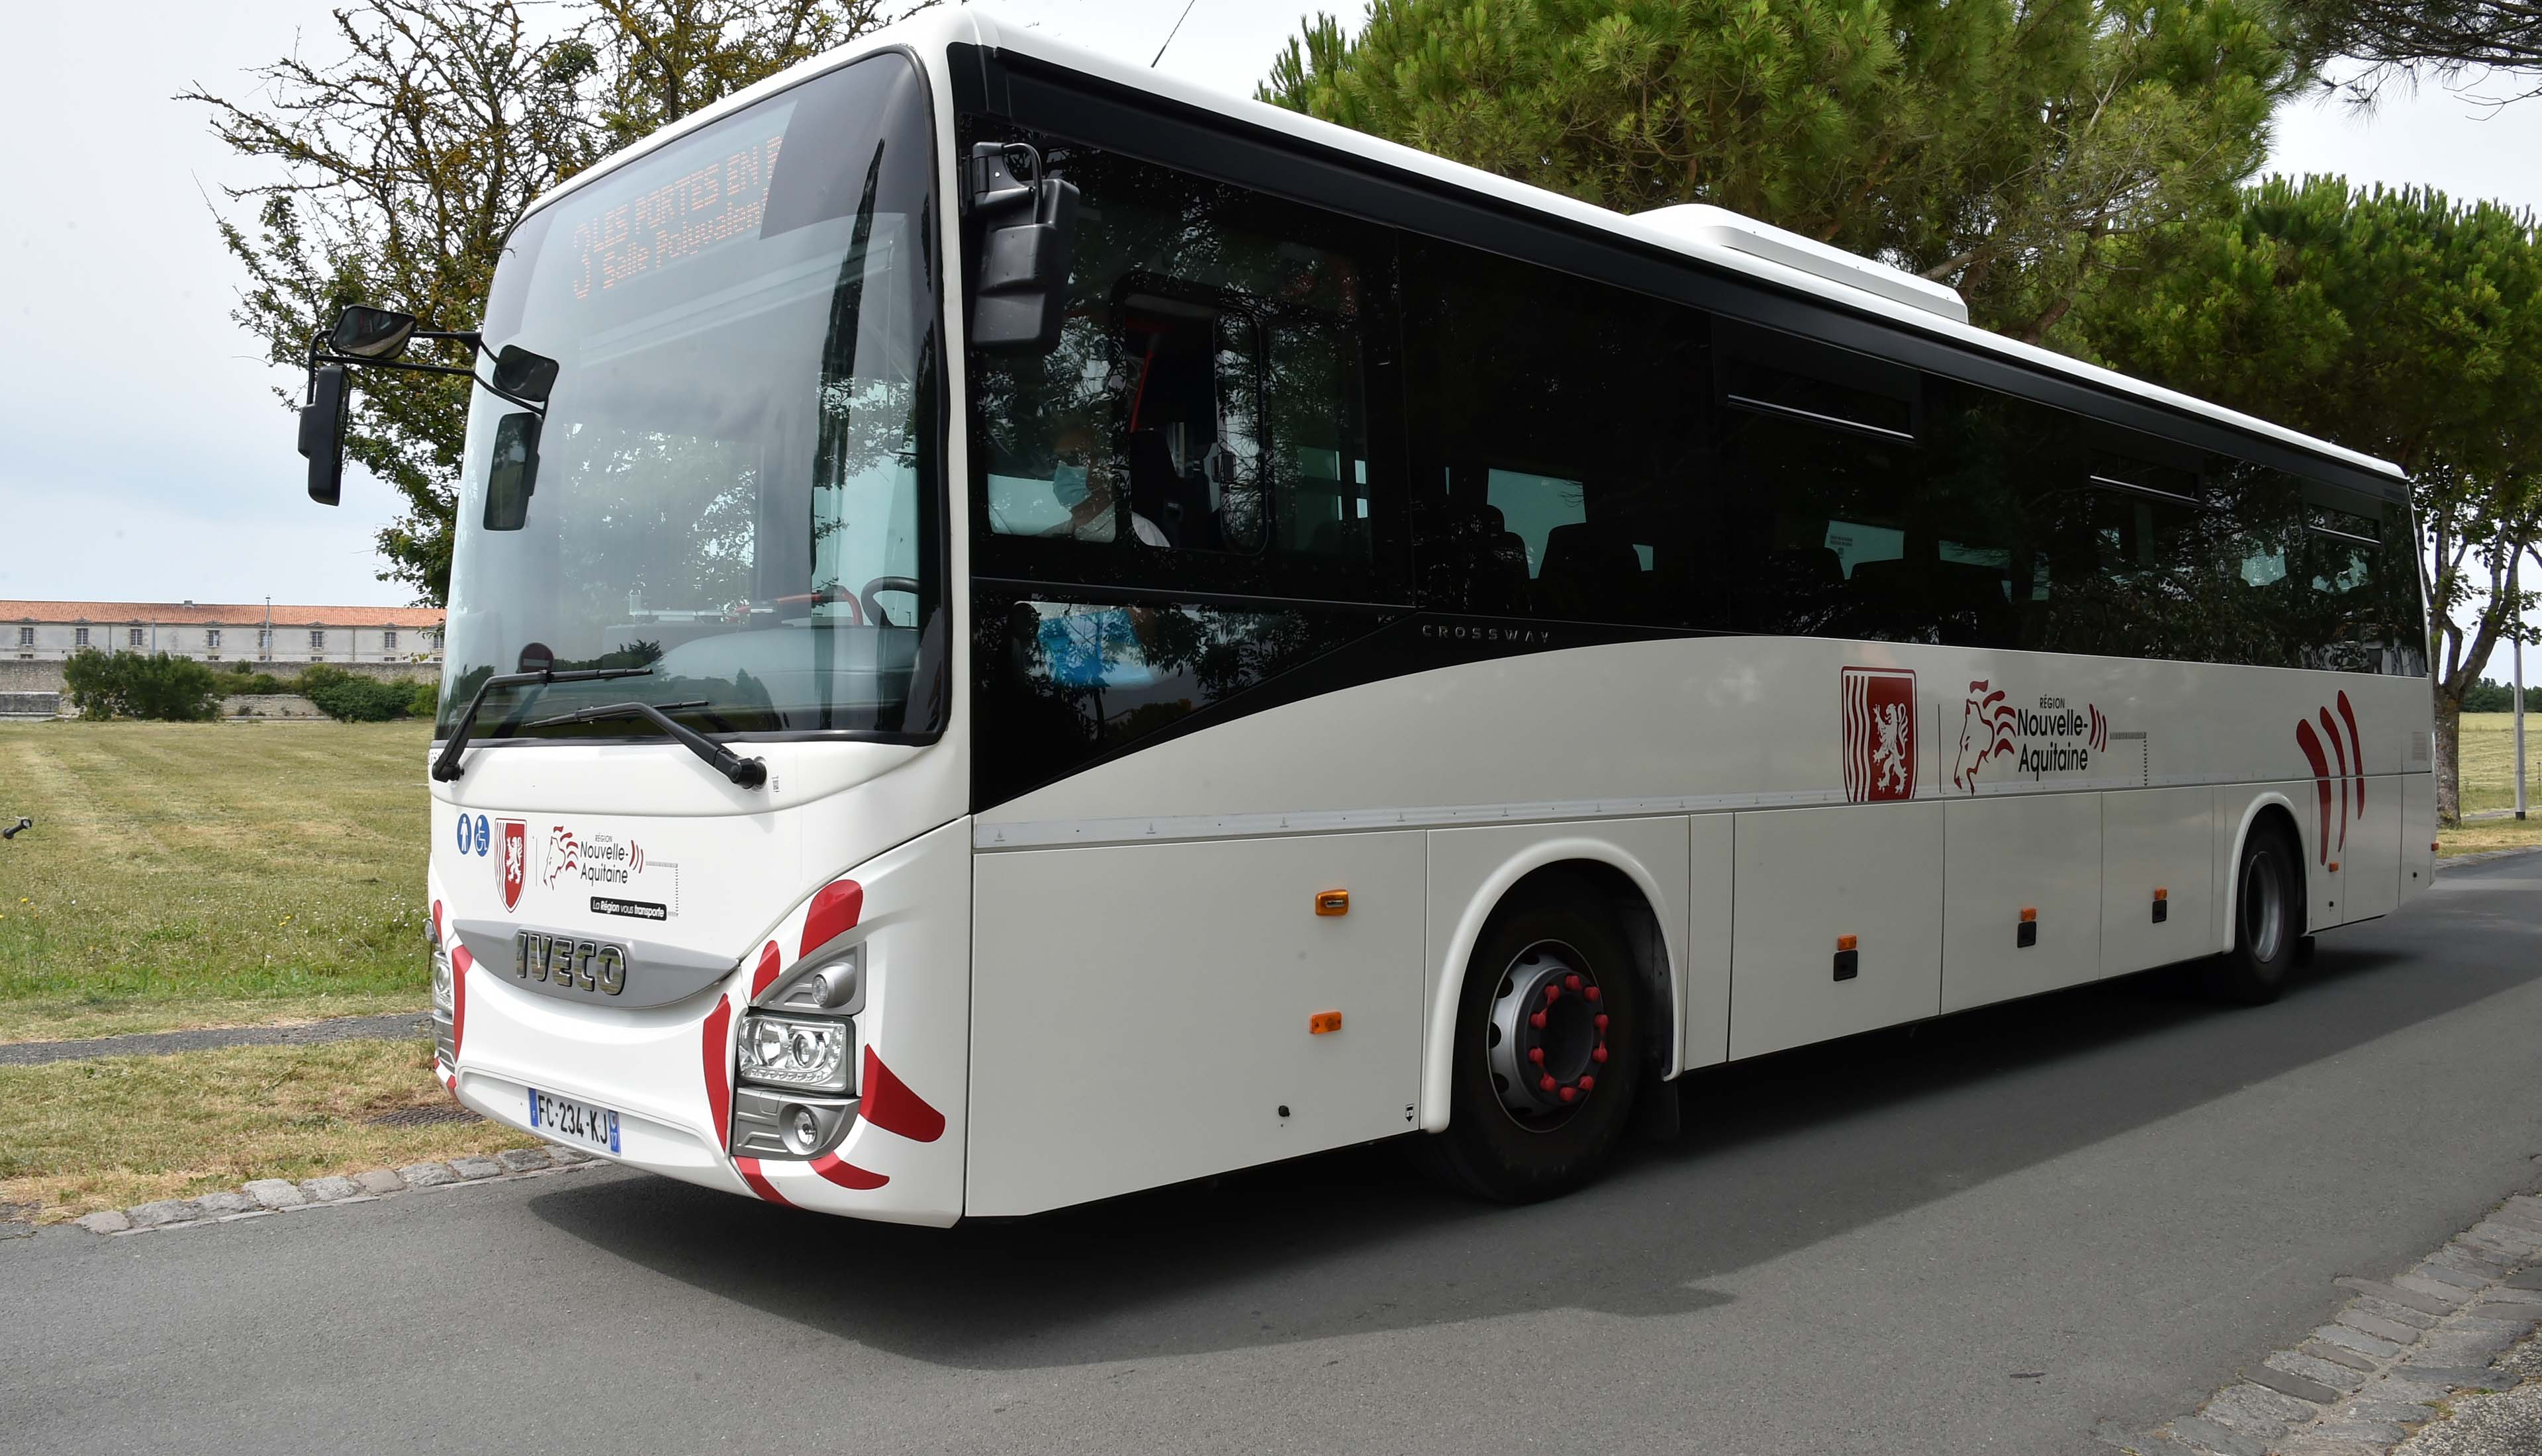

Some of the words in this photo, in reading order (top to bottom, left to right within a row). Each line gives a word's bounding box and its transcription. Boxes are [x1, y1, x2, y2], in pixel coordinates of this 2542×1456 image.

[593, 204, 629, 253] LES
[635, 163, 720, 234] PORTES
[727, 145, 758, 195] EN
[603, 242, 649, 289] Salle
[1423, 625, 1550, 643] CROSSWAY
[2039, 694, 2065, 709] RÉGION
[2017, 708, 2088, 737] Nouvelle-
[2018, 743, 2089, 782] Aquitaine
[595, 832, 612, 842] RÉGION
[580, 841, 628, 860] Nouvelle-
[580, 862, 628, 887] Aquitaine
[592, 899, 600, 910] La
[600, 900, 620, 914] Région
[620, 905, 634, 914] vous
[634, 904, 665, 918] transporte
[516, 932, 626, 995] IVECO
[610, 1132, 618, 1148] 17
